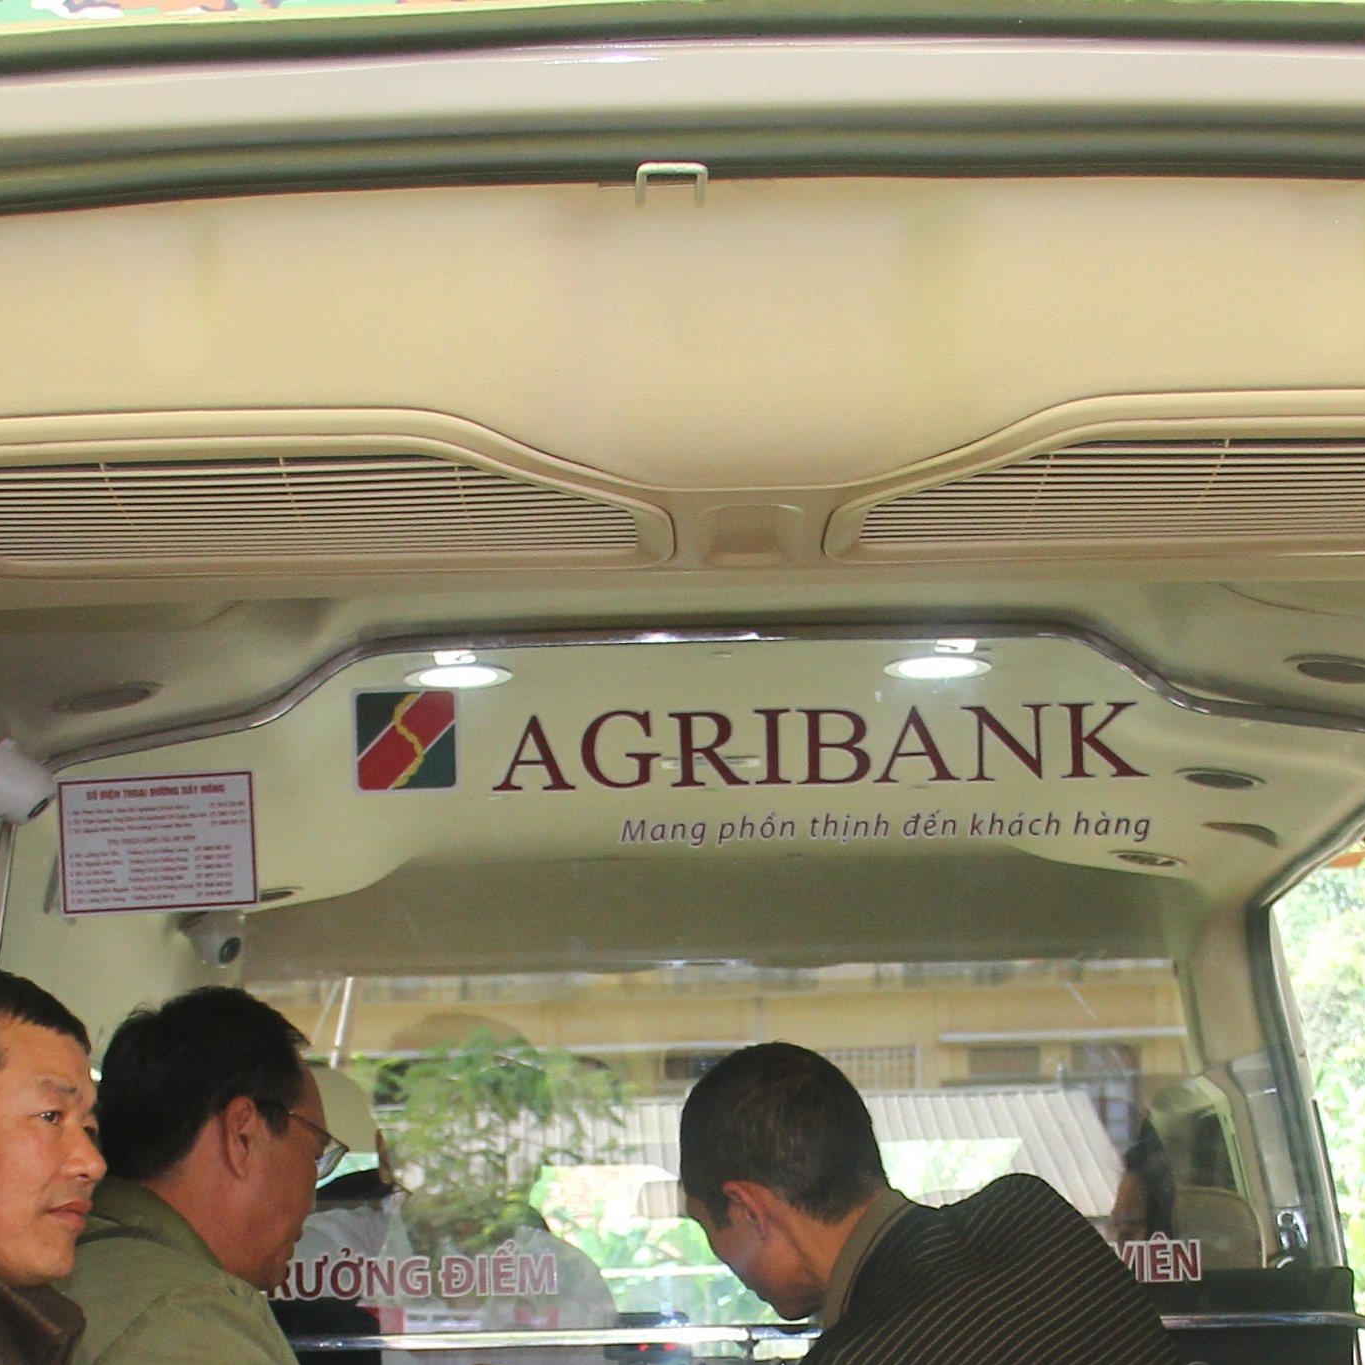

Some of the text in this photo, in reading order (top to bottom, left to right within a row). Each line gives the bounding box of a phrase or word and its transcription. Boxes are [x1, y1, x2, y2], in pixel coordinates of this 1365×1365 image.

[492, 701, 1150, 791] AGRIBANK
[620, 807, 1152, 846] Mang phồn thịnh đến khách hàng
[265, 1241, 558, 1300] RƯỞNG ĐIỂM
